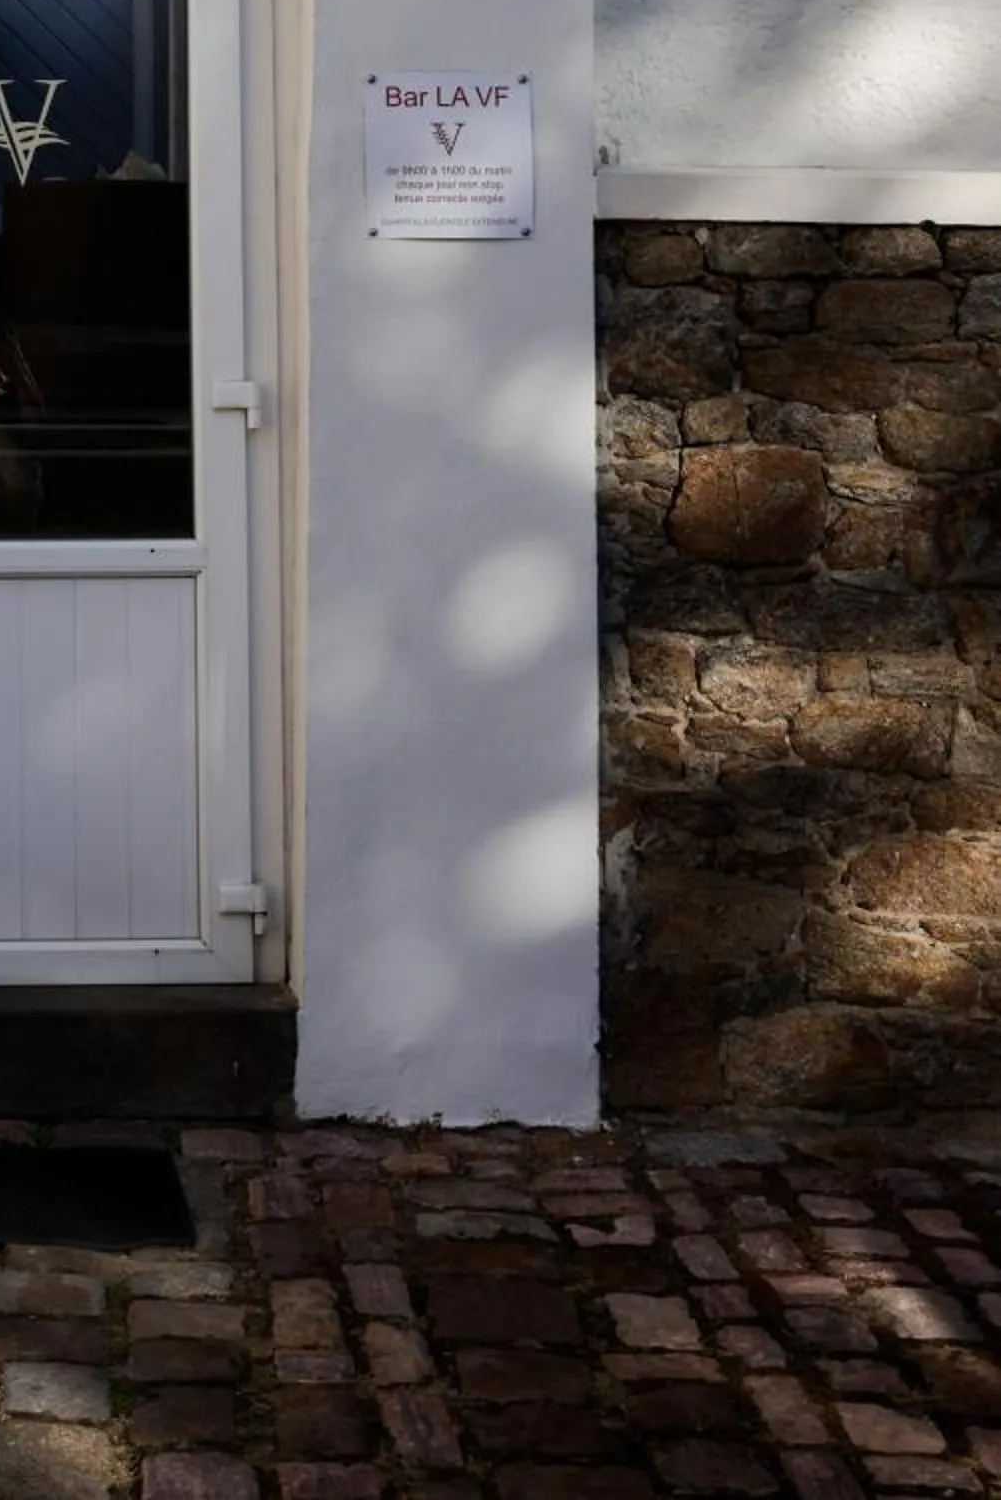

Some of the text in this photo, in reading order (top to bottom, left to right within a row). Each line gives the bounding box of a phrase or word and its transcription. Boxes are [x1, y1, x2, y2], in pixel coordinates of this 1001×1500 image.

[385, 85, 510, 108] Bar LA VF
